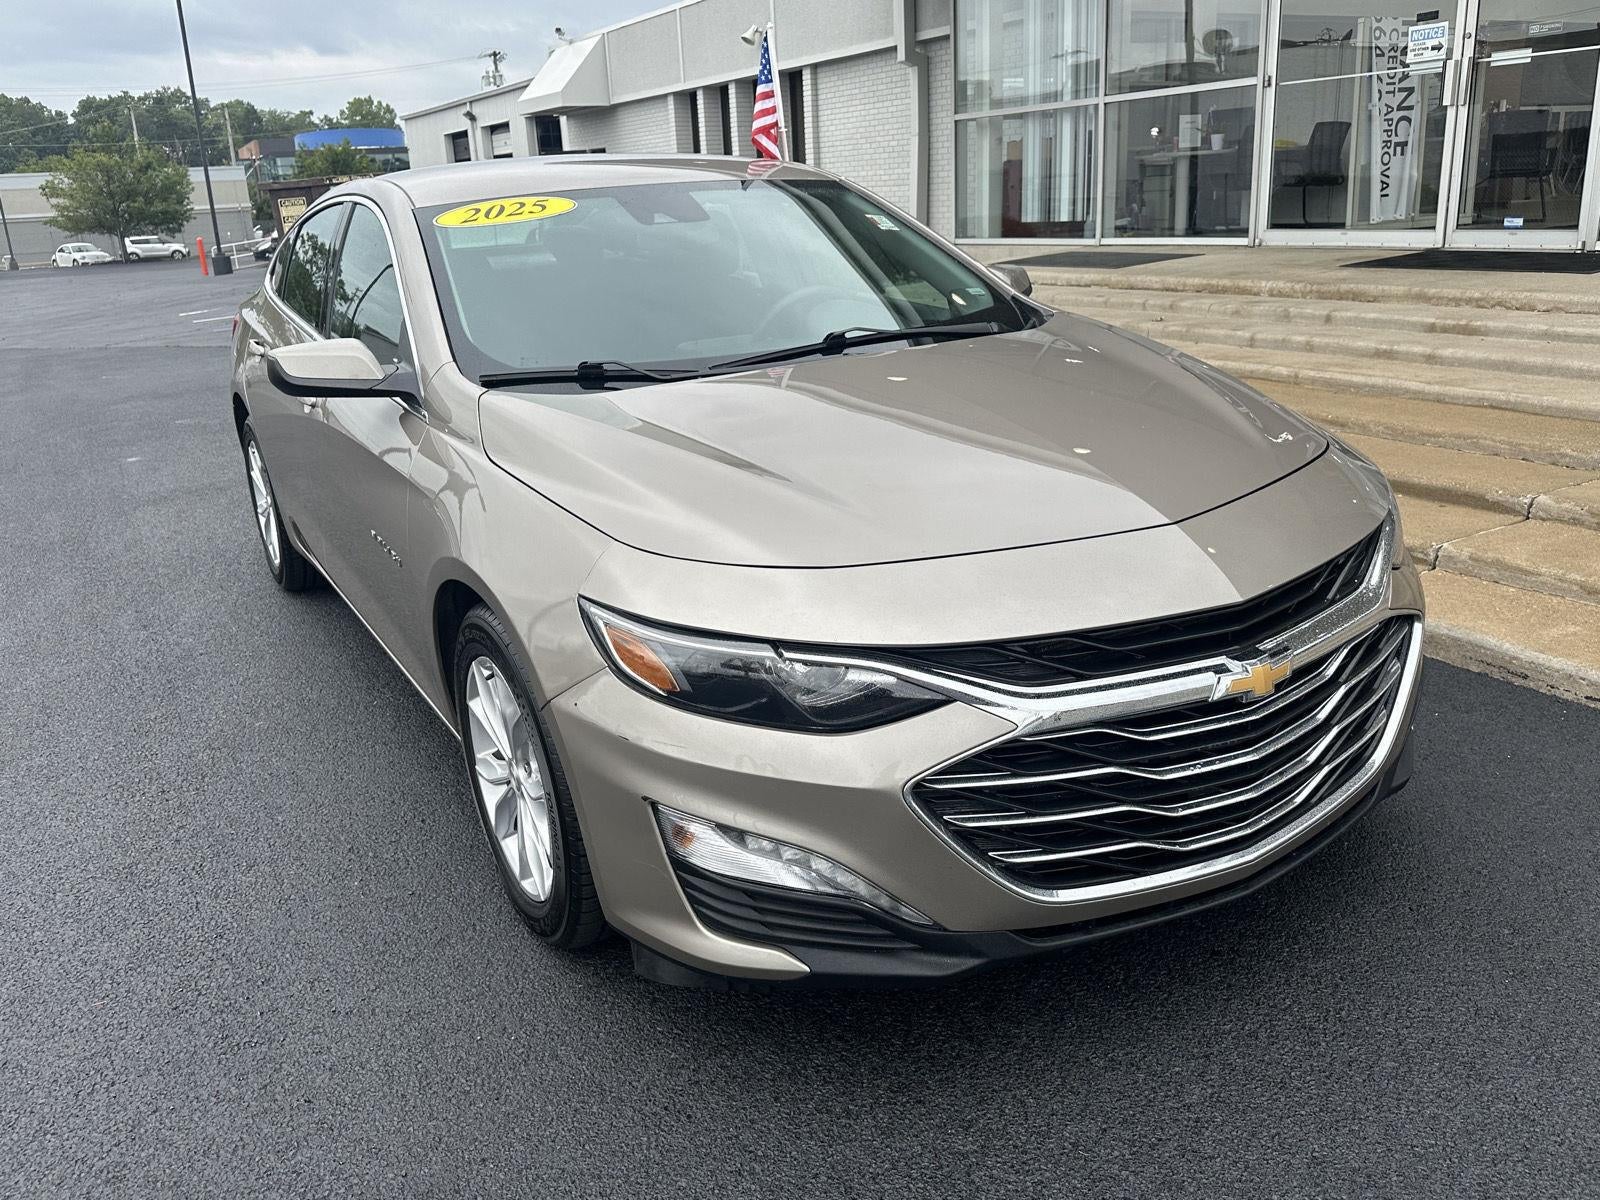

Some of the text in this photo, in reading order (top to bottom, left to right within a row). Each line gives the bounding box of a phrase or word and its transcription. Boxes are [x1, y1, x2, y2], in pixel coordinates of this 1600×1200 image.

[1412, 27, 1444, 41] NOTICE
[1385, 28, 1400, 98] CREDIT
[281, 198, 305, 207] CAUTION
[460, 199, 549, 225] 2025
[545, 791, 560, 852] TOURING
